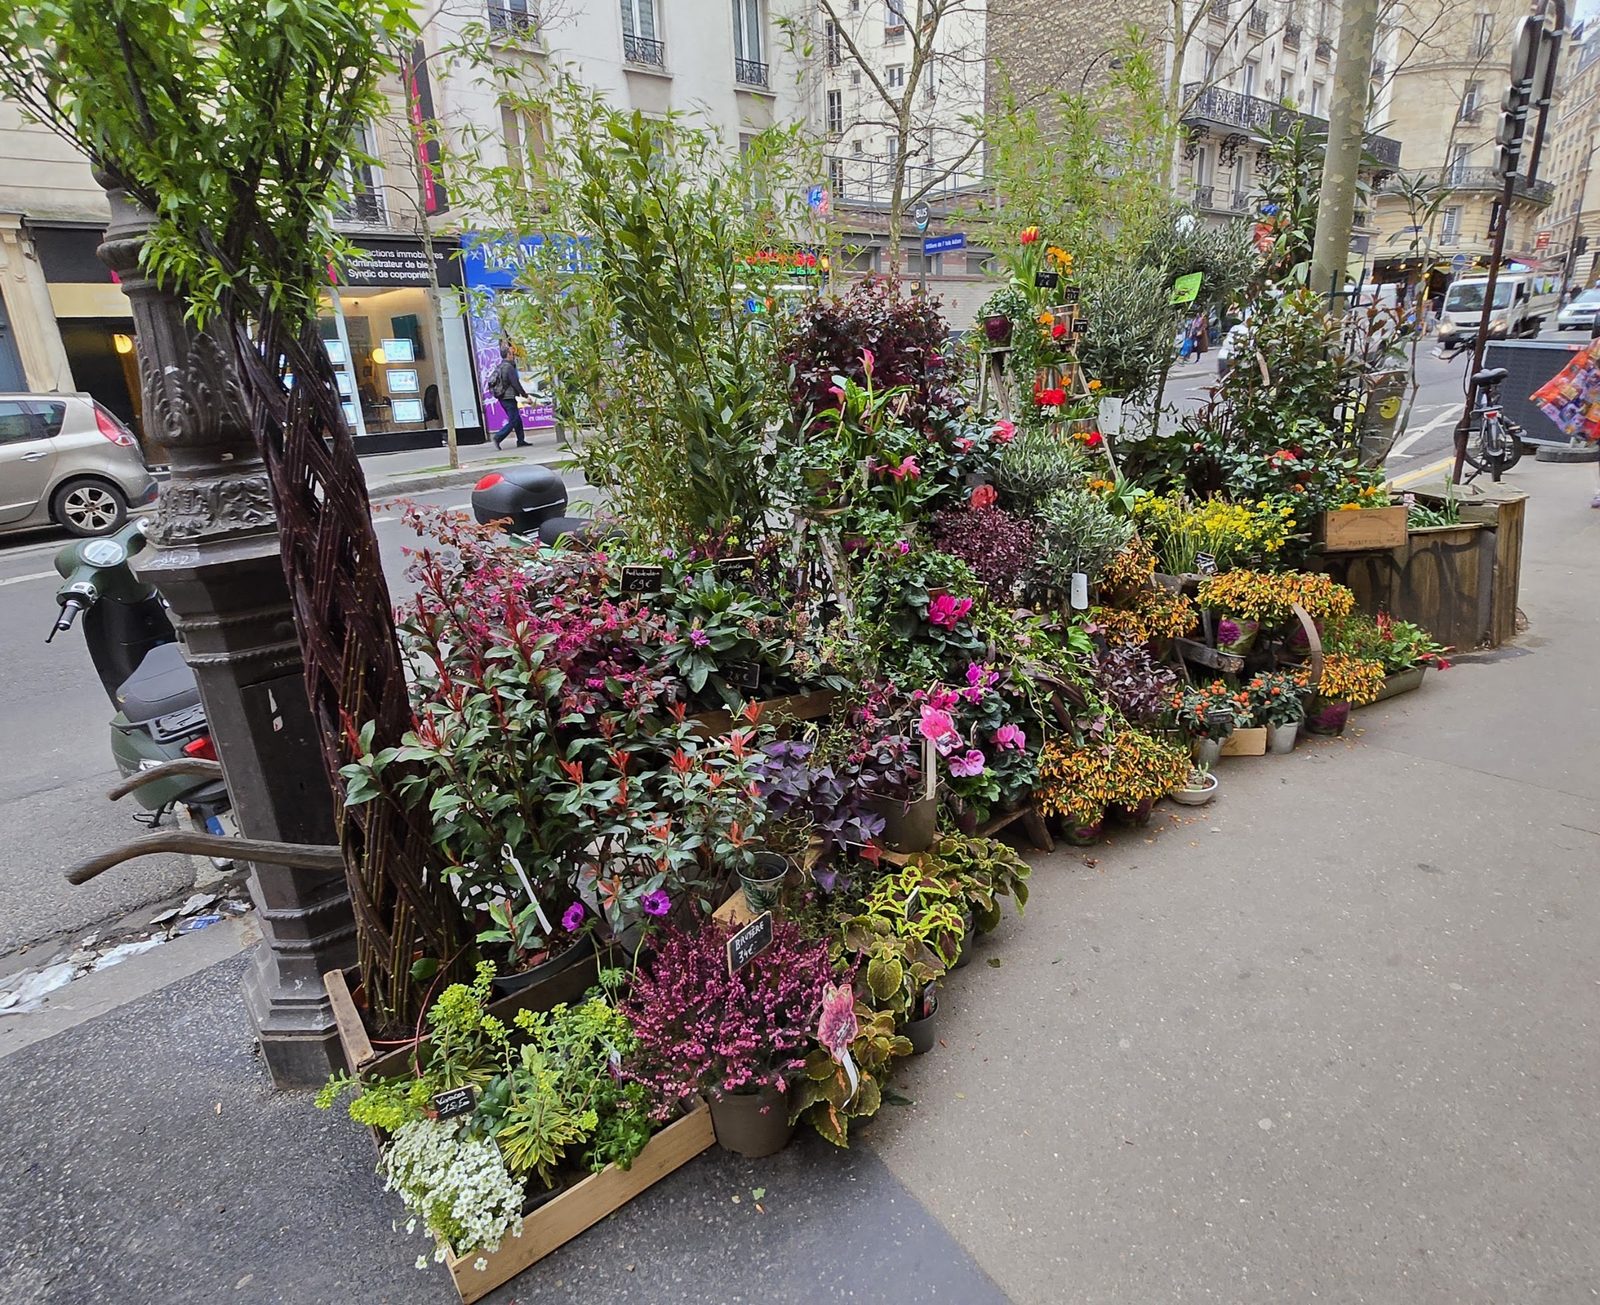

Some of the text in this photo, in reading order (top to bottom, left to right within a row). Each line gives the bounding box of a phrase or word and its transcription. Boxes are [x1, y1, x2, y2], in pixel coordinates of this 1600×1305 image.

[915, 207, 928, 219] BUS
[404, 260, 416, 269] de
[348, 268, 431, 280] Syndic de copropriét
